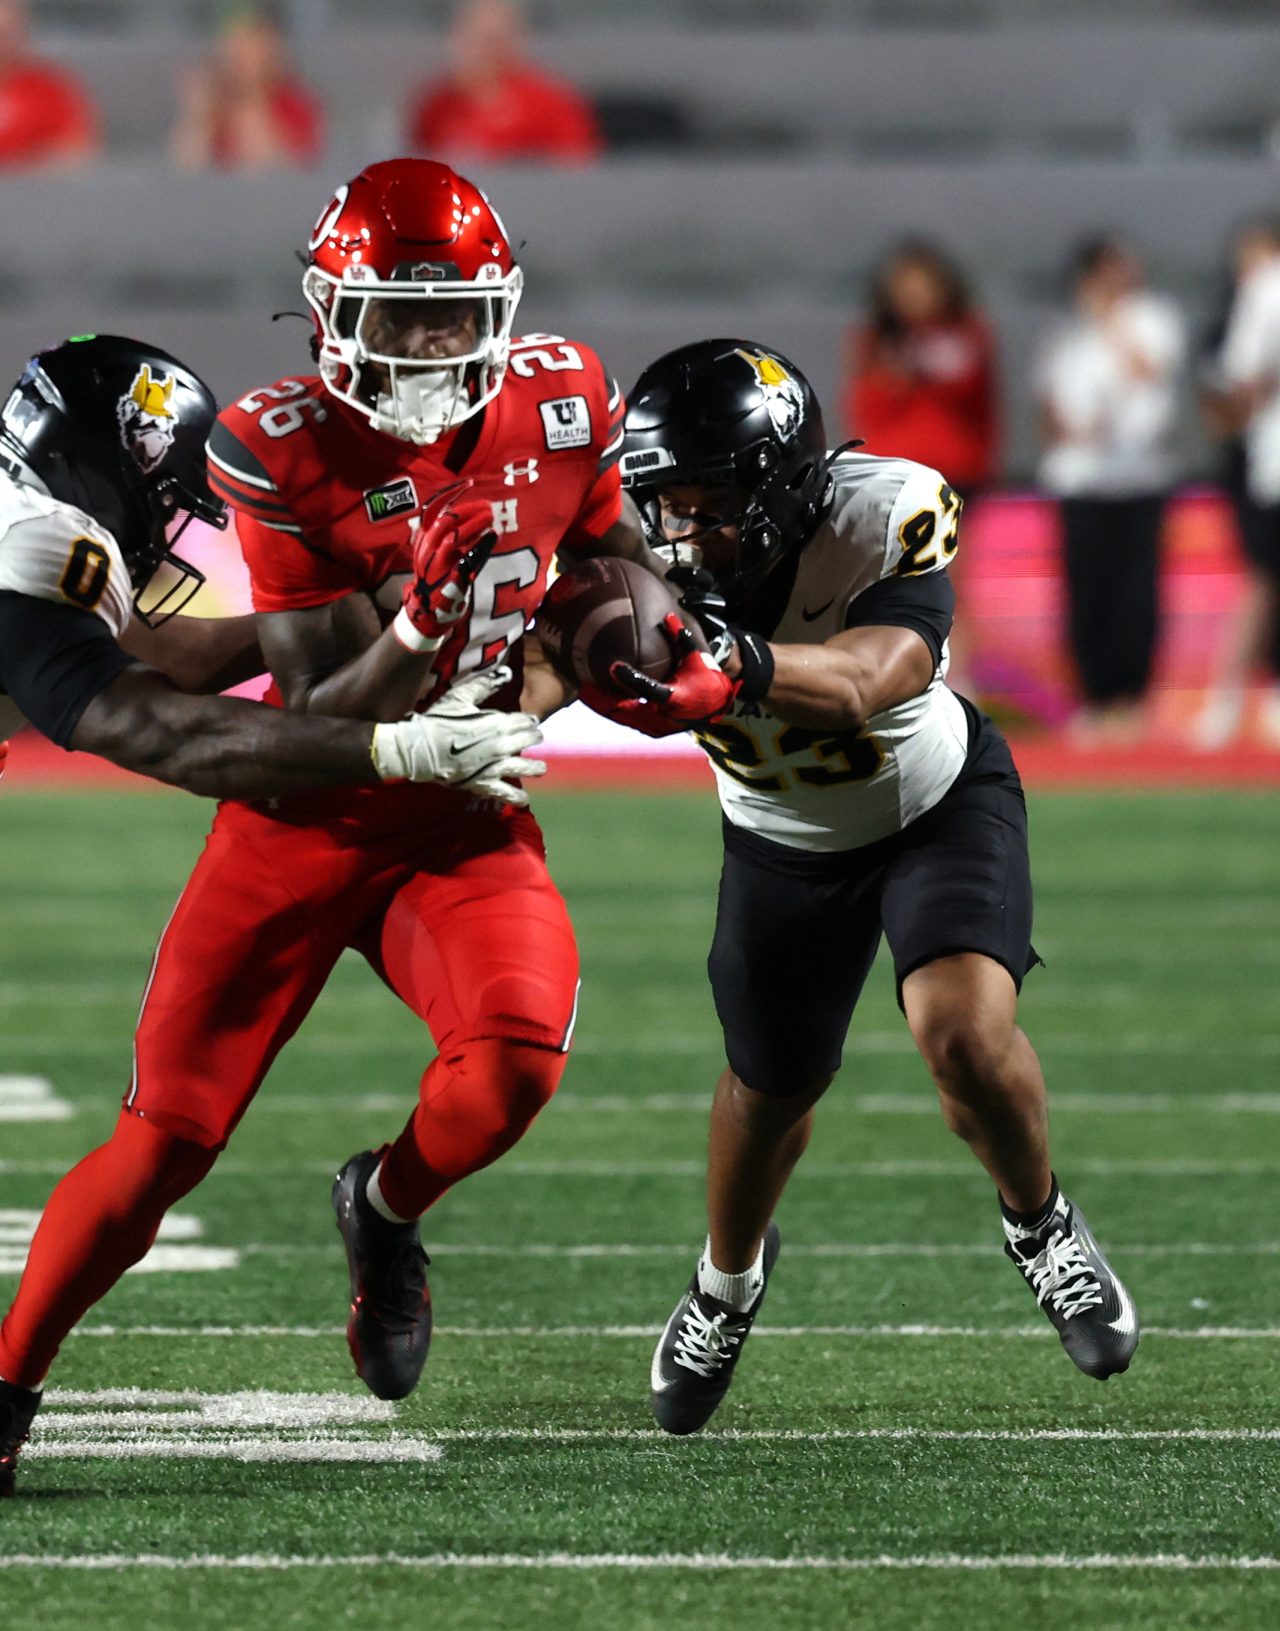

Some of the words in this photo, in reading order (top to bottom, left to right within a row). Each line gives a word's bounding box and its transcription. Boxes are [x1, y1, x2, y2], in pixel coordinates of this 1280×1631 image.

[236, 381, 327, 438] 26
[549, 428, 589, 441] HEALTH
[624, 451, 660, 471] IDAHO
[891, 482, 964, 578] 23
[59, 534, 111, 610] 0
[696, 718, 885, 791] 23
